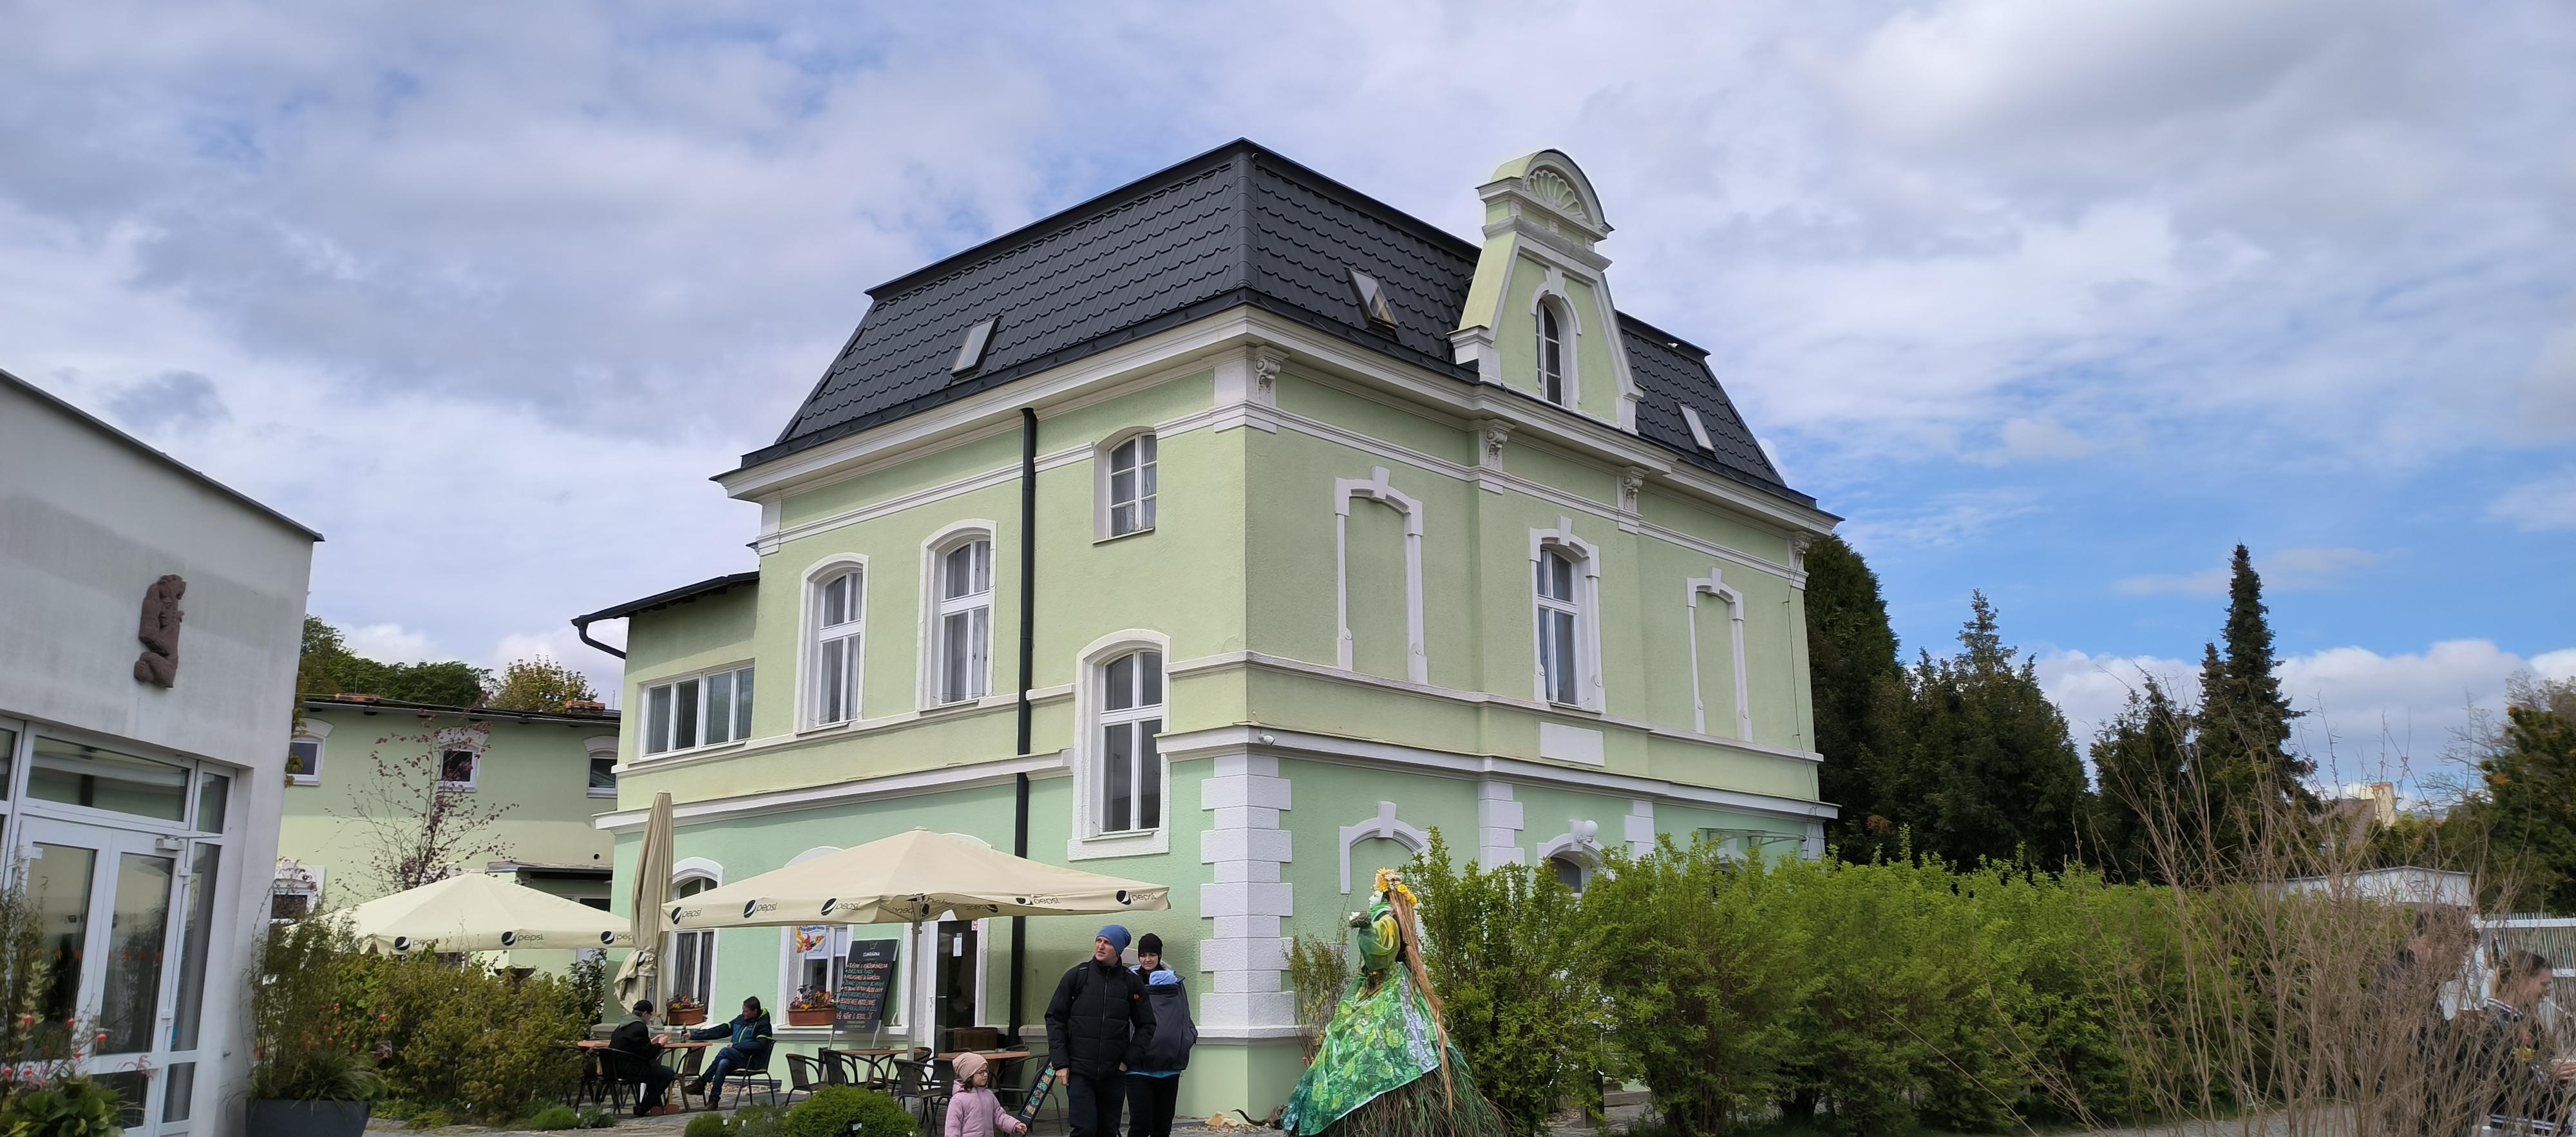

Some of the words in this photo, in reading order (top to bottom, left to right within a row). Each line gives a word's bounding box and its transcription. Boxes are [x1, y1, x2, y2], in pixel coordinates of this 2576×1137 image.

[1131, 892, 1157, 903] pepsi
[755, 902, 777, 913] pepsi
[834, 902, 861, 912] pepsi
[681, 908, 703, 919] pepsi
[517, 933, 544, 942] pepsi
